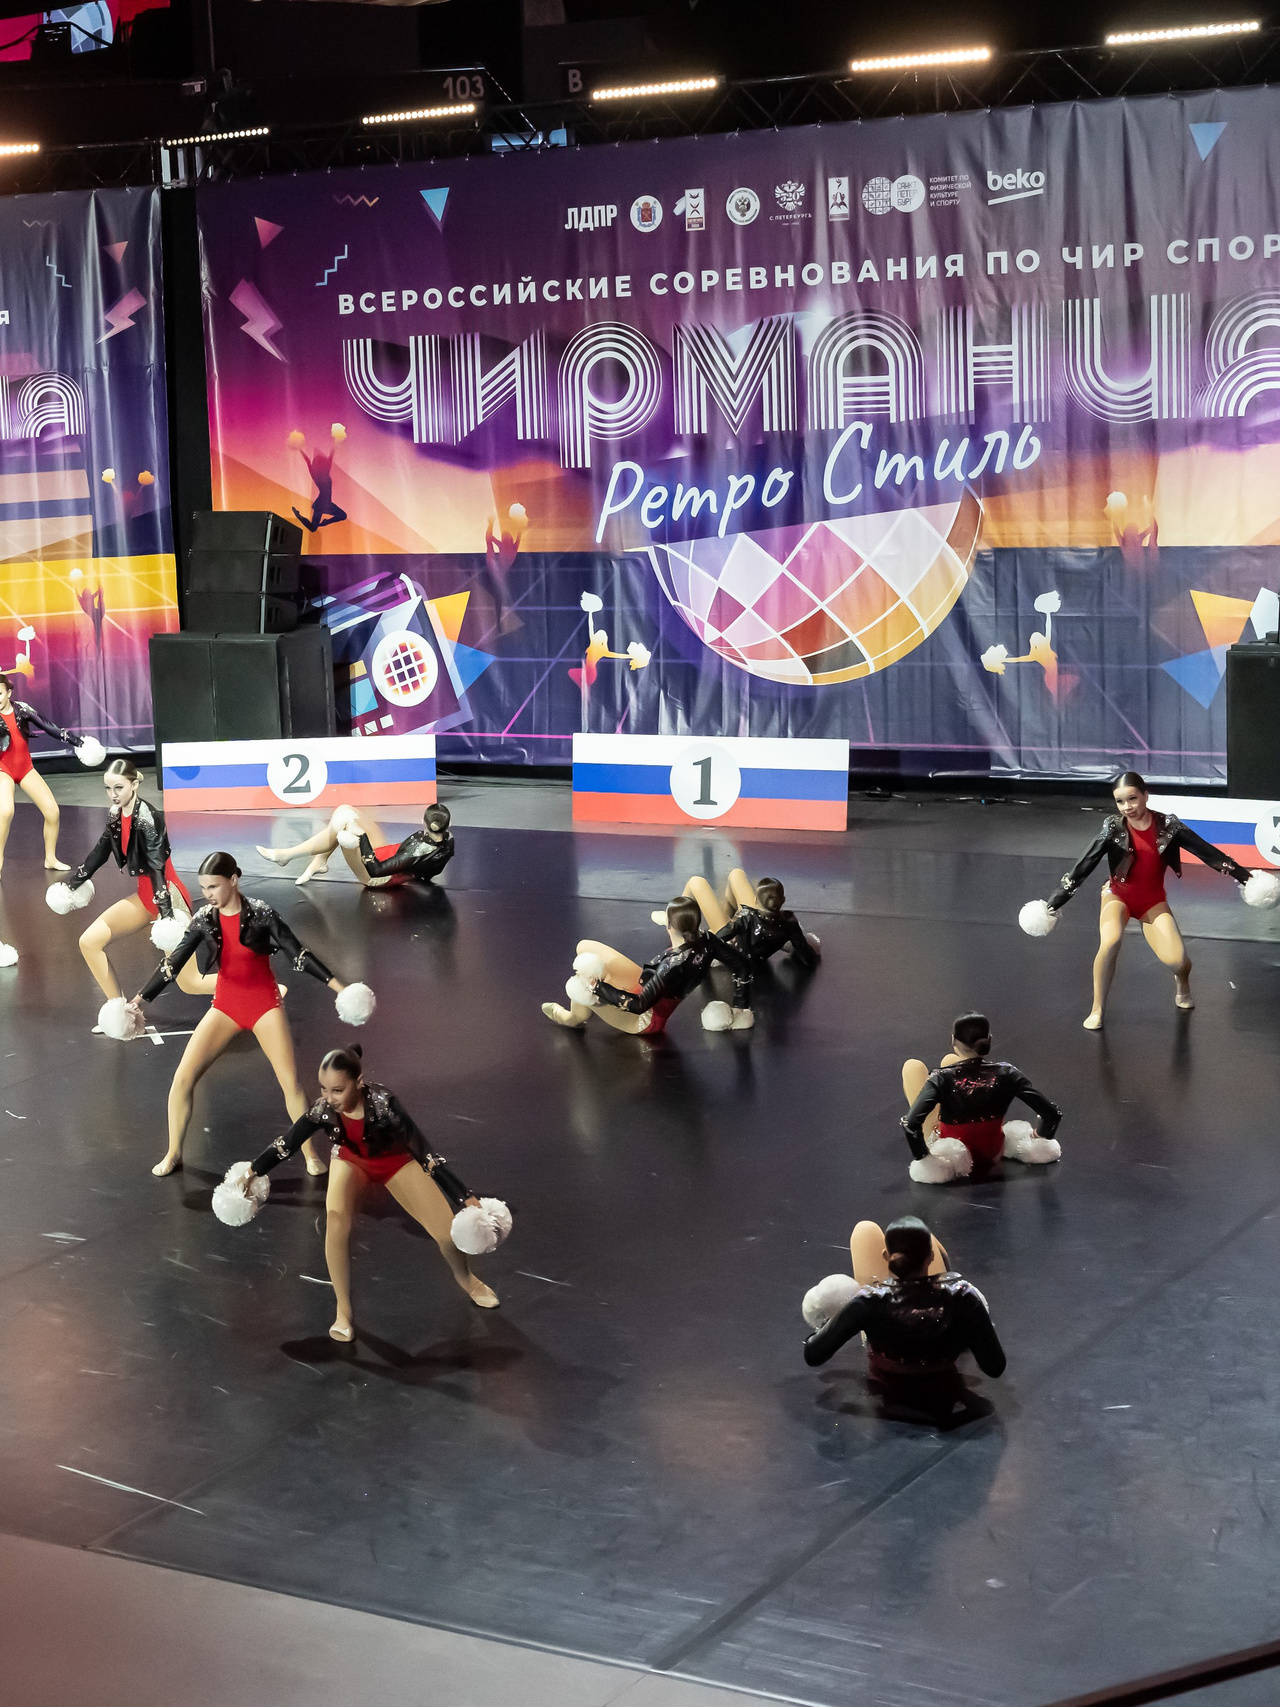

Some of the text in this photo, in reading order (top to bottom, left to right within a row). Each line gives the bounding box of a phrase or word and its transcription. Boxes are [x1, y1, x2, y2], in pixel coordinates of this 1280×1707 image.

[442, 75, 484, 99] 103
[987, 168, 1045, 191] beko
[564, 204, 618, 232] ЛДПР
[338, 275, 632, 315] ВСЕРОССИЙСКИЕ
[650, 253, 964, 296] СОРЕВНОВАНИЯ
[987, 248, 1041, 275] ПО
[1061, 243, 1144, 270] ЧИР
[594, 420, 1042, 544] Ретро Стиль
[283, 754, 311, 793] 2
[693, 757, 718, 805] 1
